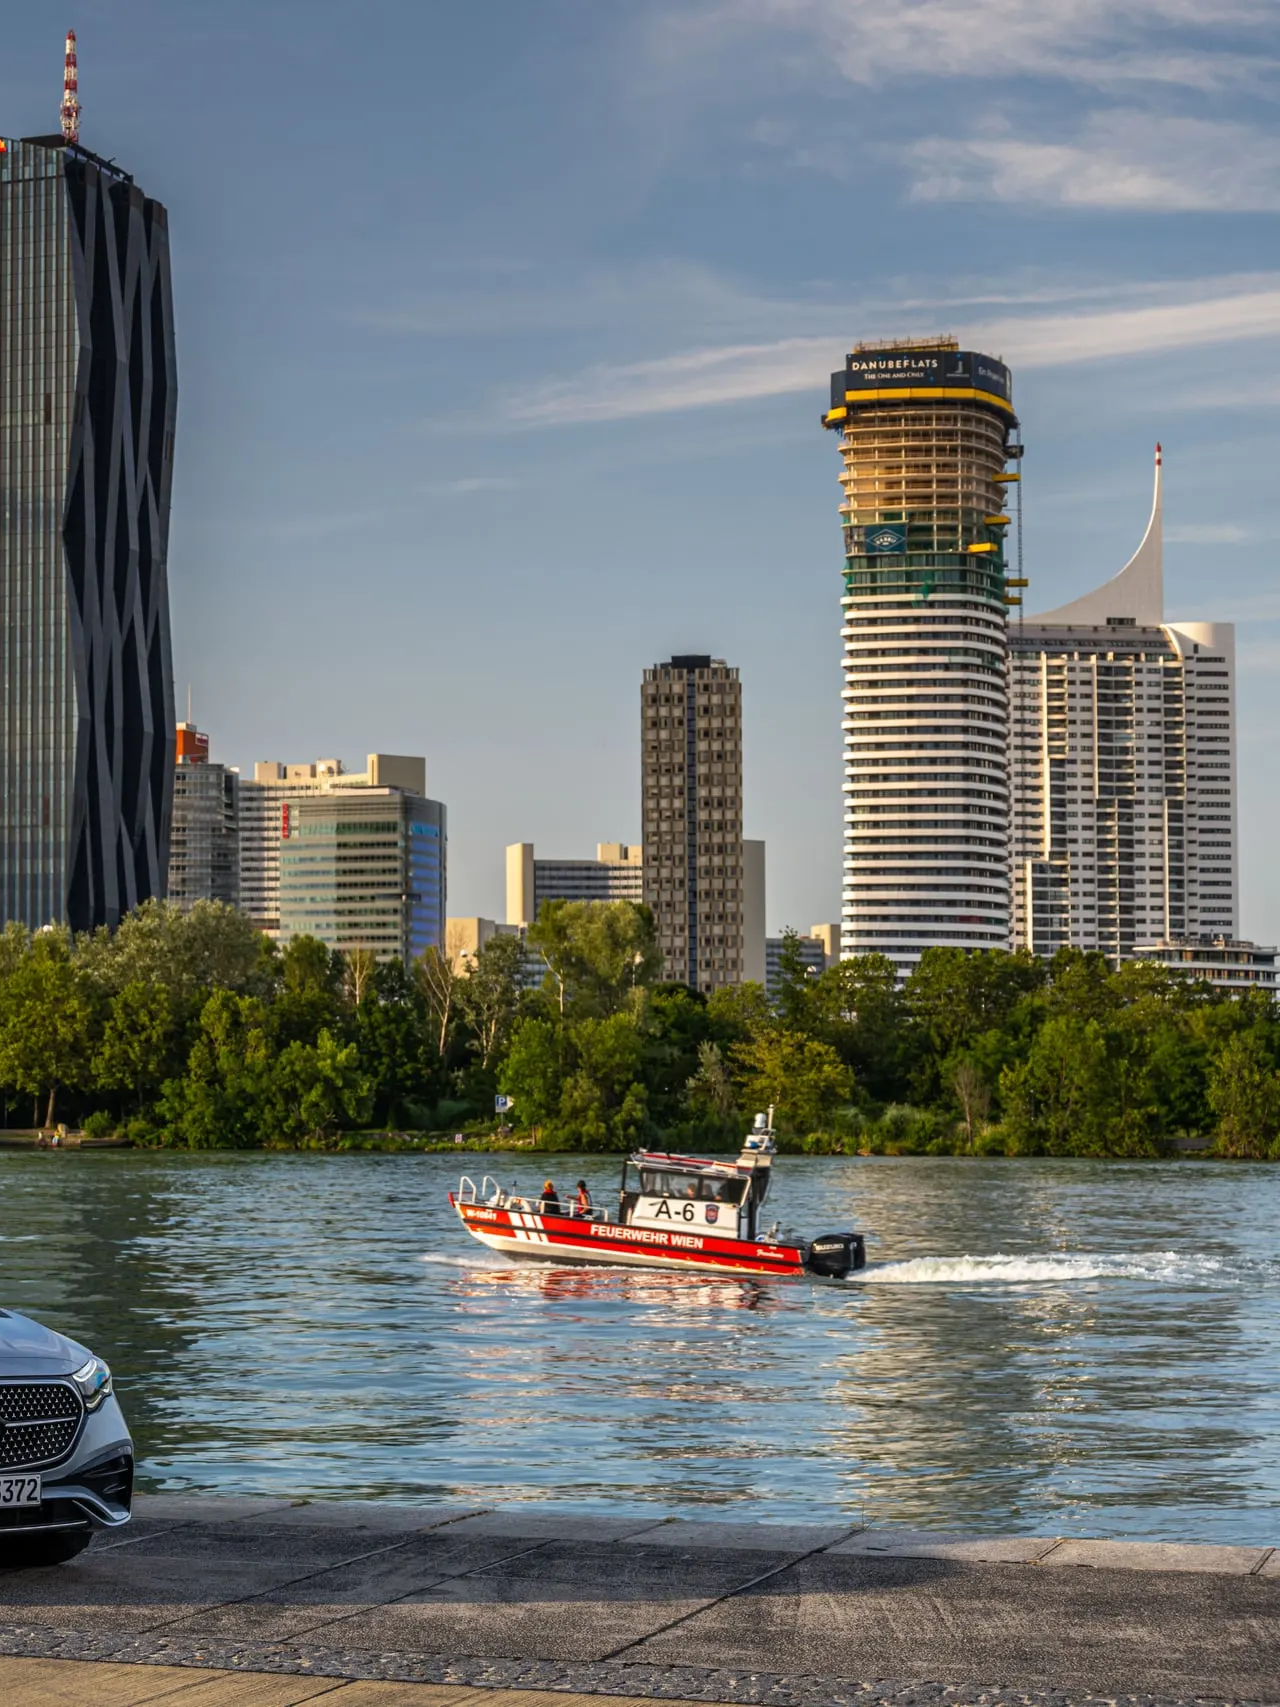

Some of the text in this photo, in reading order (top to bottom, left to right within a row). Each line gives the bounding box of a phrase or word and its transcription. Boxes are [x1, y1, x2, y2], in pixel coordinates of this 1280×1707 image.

[852, 359, 938, 371] DANUBEFLATS
[499, 1097, 506, 1106] P
[655, 1200, 695, 1222] A-6
[590, 1224, 704, 1249] FEUERWEHR WIEN
